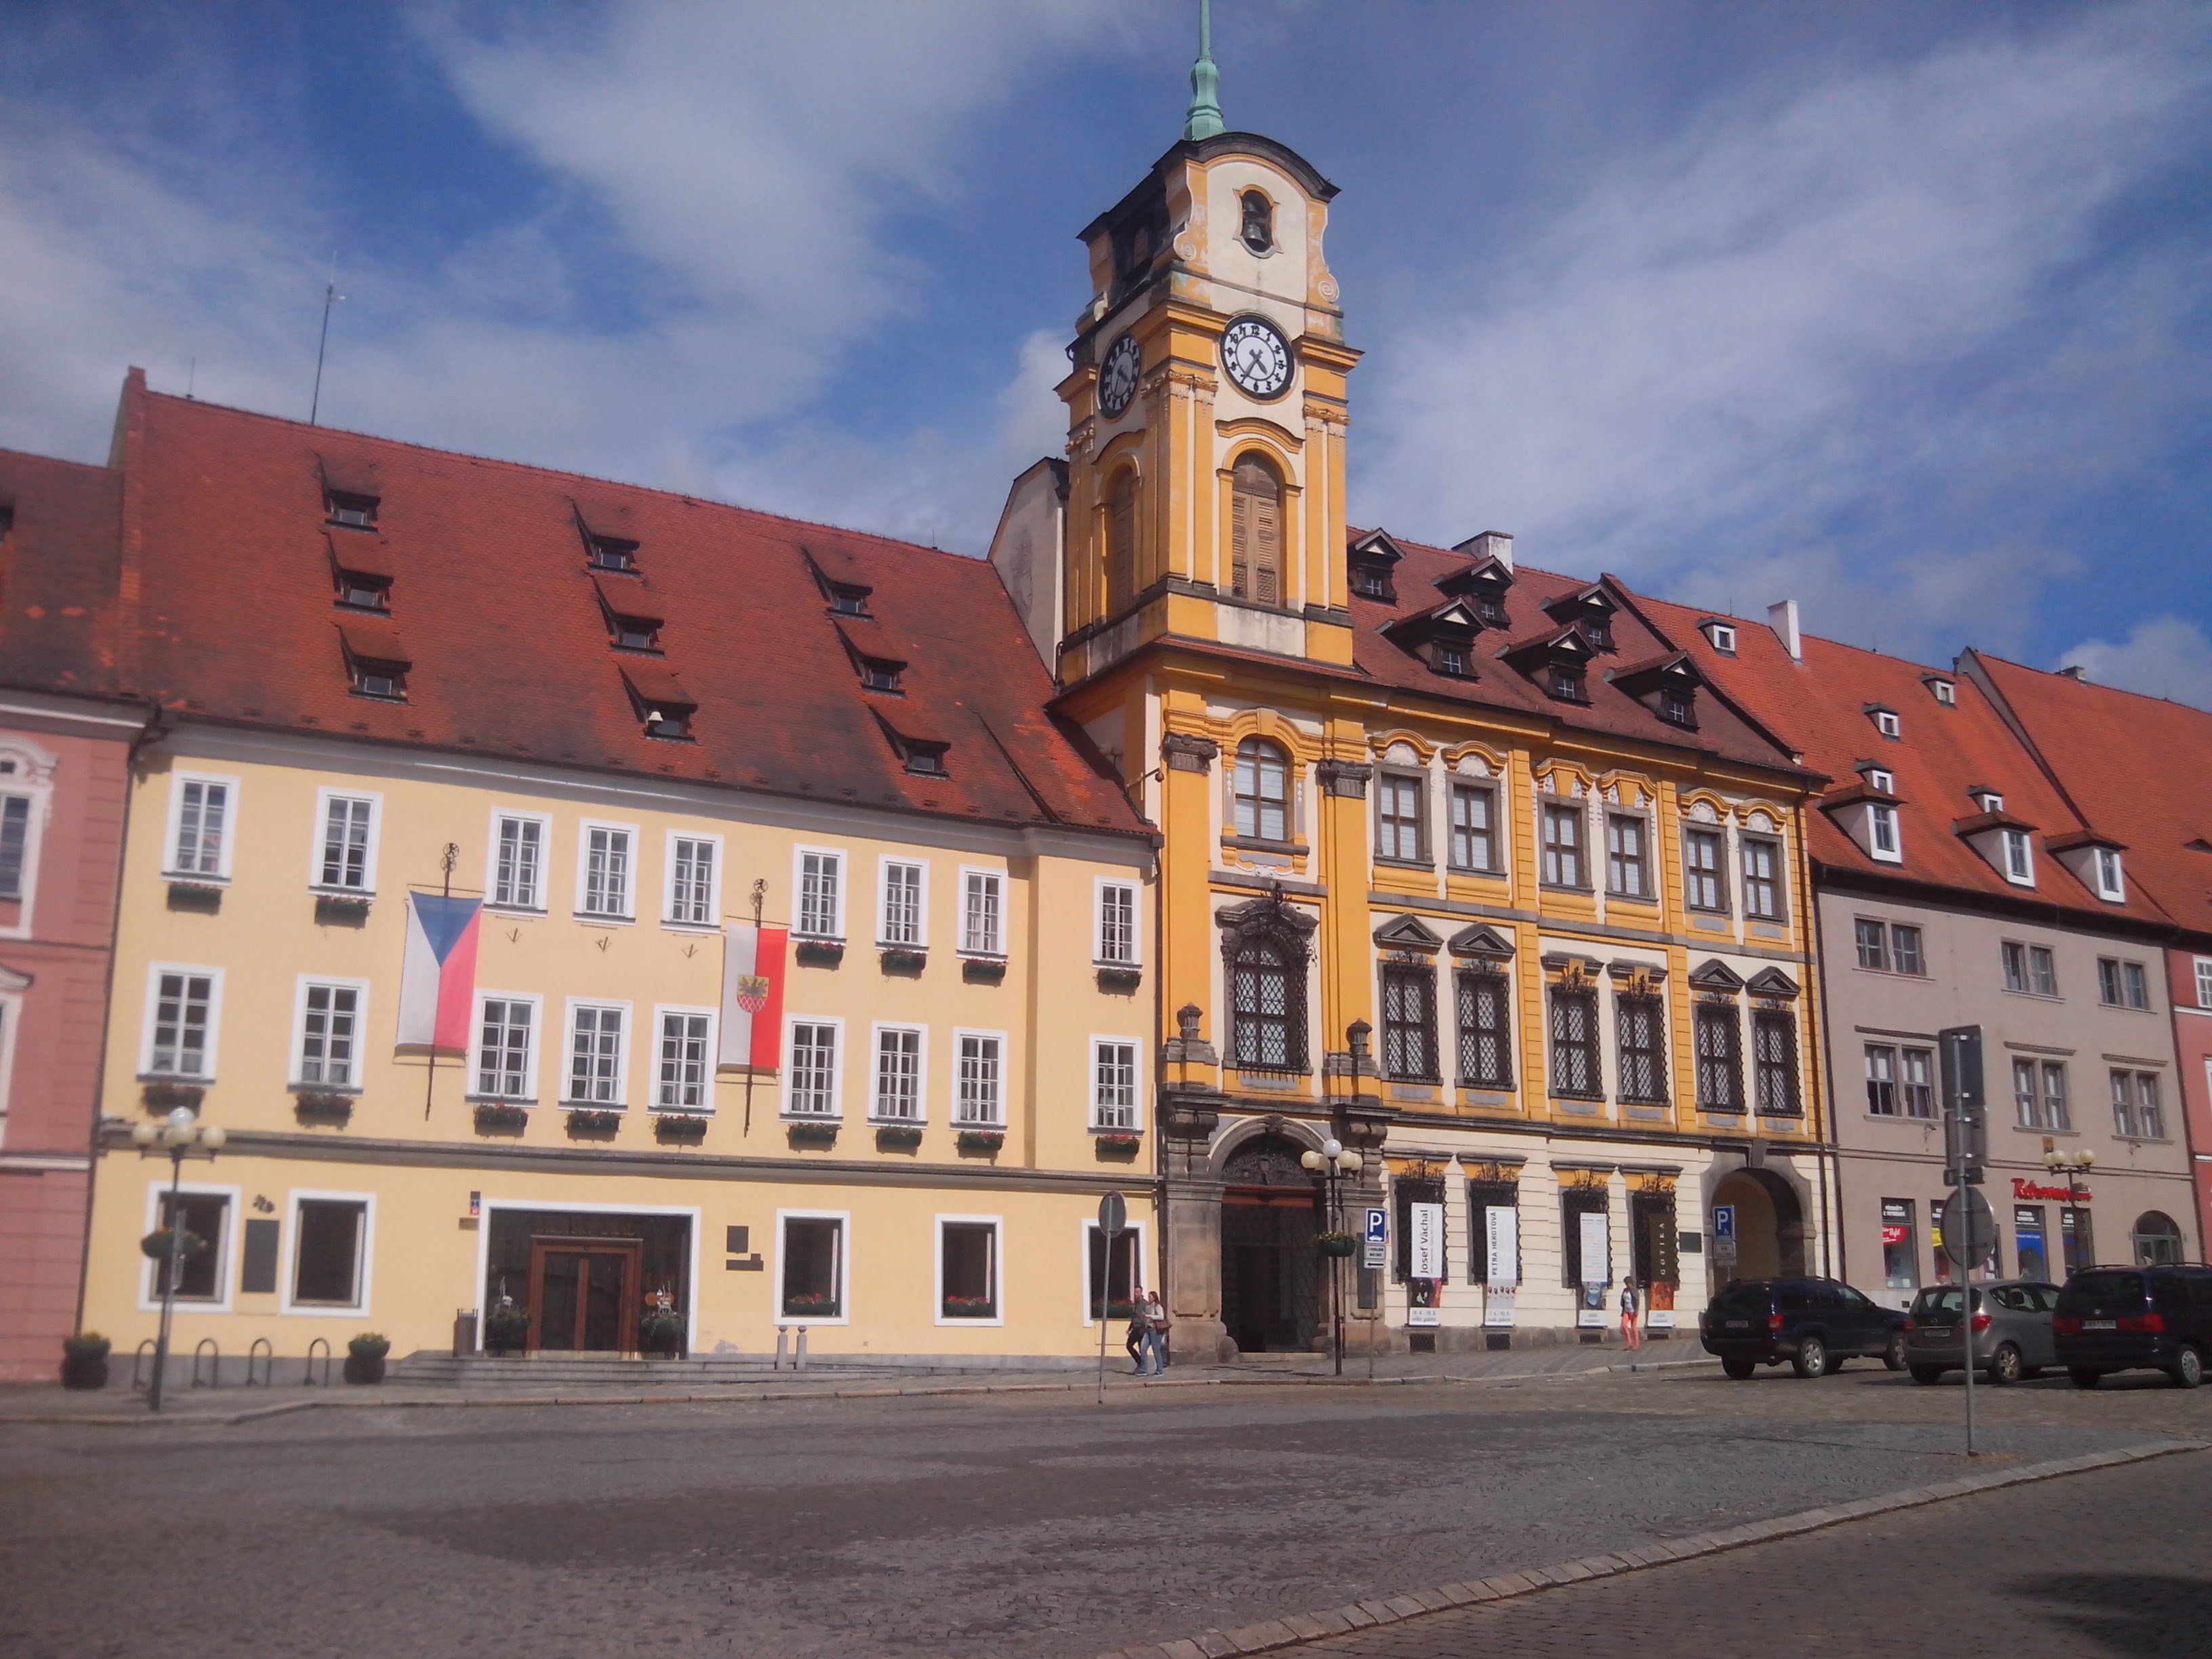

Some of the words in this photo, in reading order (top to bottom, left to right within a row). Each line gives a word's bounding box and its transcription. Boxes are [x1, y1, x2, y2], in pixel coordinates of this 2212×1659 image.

[1251, 325, 1260, 335] 12
[1229, 333, 1239, 344] 10
[1267, 331, 1272, 342] 1
[1227, 347, 1233, 357] 9
[1275, 345, 1282, 354] 2
[1231, 361, 1237, 371] 8
[1278, 360, 1284, 370] 3
[1274, 373, 1283, 383] 4
[1253, 380, 1259, 392] 6
[1266, 381, 1272, 391] 5
[1370, 1212, 1382, 1233] P
[1717, 1210, 1729, 1231] P
[1420, 1247, 1429, 1274] Josef
